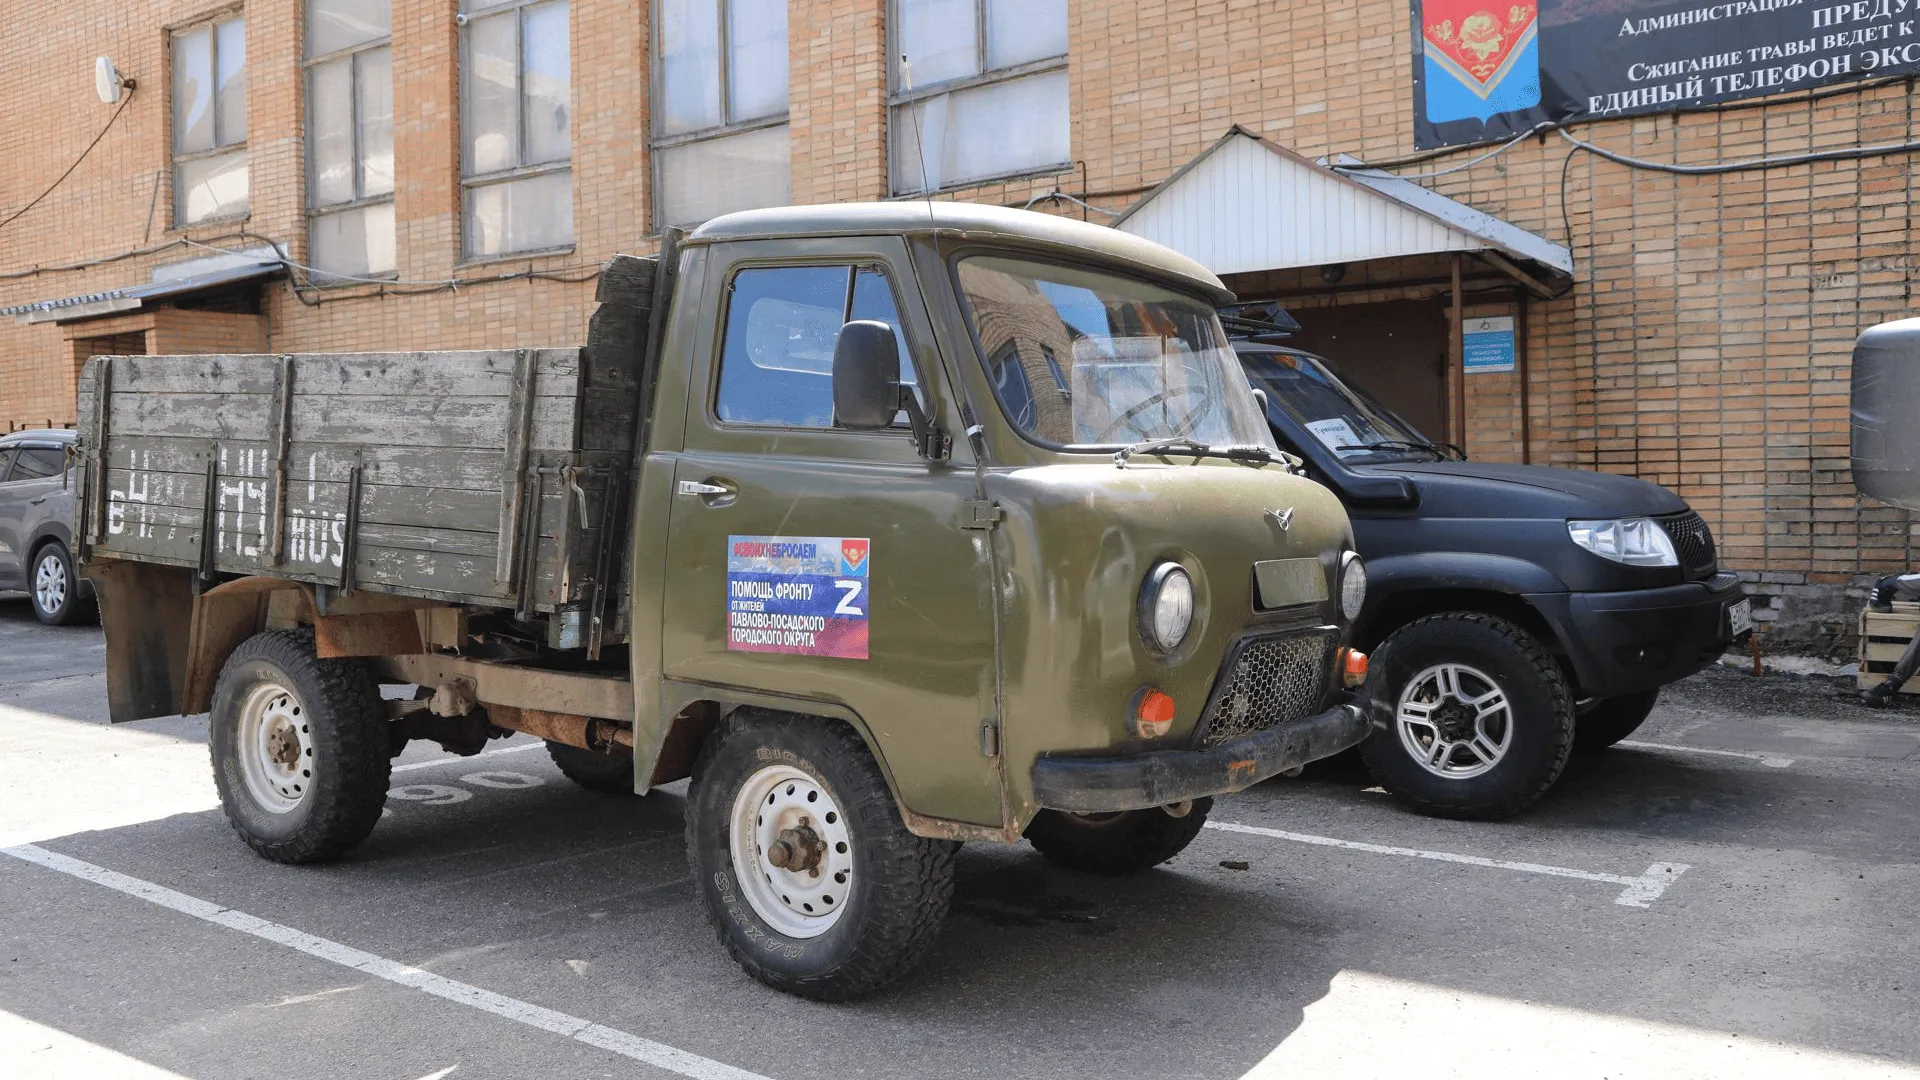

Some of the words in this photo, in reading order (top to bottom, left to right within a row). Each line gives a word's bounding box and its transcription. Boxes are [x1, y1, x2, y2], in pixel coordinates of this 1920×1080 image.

[1812, 0, 1920, 29] ПРЕДУ
[1747, 37, 1817, 63] ТРАВЫ
[1823, 23, 1893, 50] ВЕДЕТ
[1899, 20, 1914, 36] К
[1588, 75, 1704, 116] ЕДИНЫЙ
[1710, 53, 1853, 95] ТЕЛЕФОН
[1860, 42, 1920, 71] ЭКС
[731, 581, 773, 601] ПОМОЩЬ
[775, 583, 814, 600] ФРОНТУ
[731, 600, 739, 611] ОТ
[739, 599, 764, 612] ЖИТЕЛЕЙ
[834, 580, 863, 615] Z
[731, 612, 825, 632] ПАВЛОВО-ПОСАДСКОГО
[731, 628, 782, 646] ГОРОДСКОГО
[784, 632, 816, 648] ОКРУГА
[714, 871, 804, 958] MAXXIS
